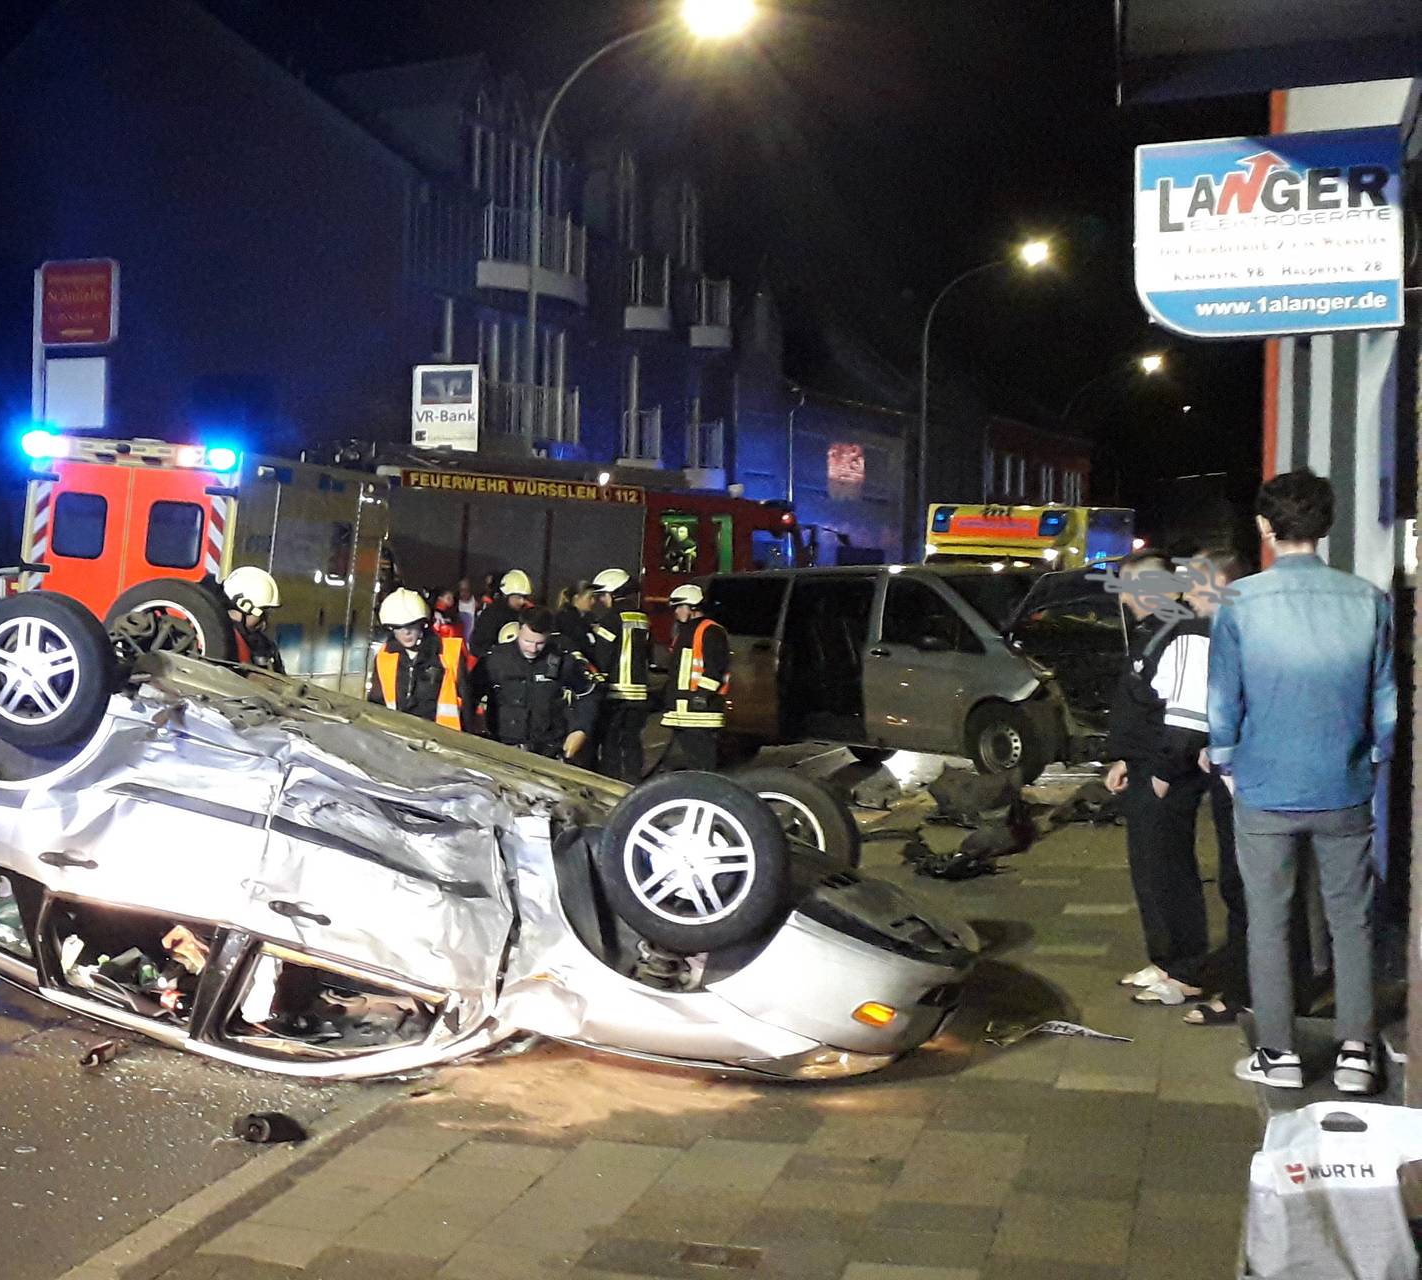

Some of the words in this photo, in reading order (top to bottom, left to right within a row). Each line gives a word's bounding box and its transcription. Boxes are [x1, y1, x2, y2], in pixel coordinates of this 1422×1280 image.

[1158, 151, 1391, 232] LANGER
[1196, 291, 1388, 317] www.1alanger.de
[415, 409, 476, 423] VR-Bank
[409, 471, 508, 494] FEUERWEHR
[614, 489, 639, 503] 112
[1306, 1163, 1375, 1179] WÜRTH
